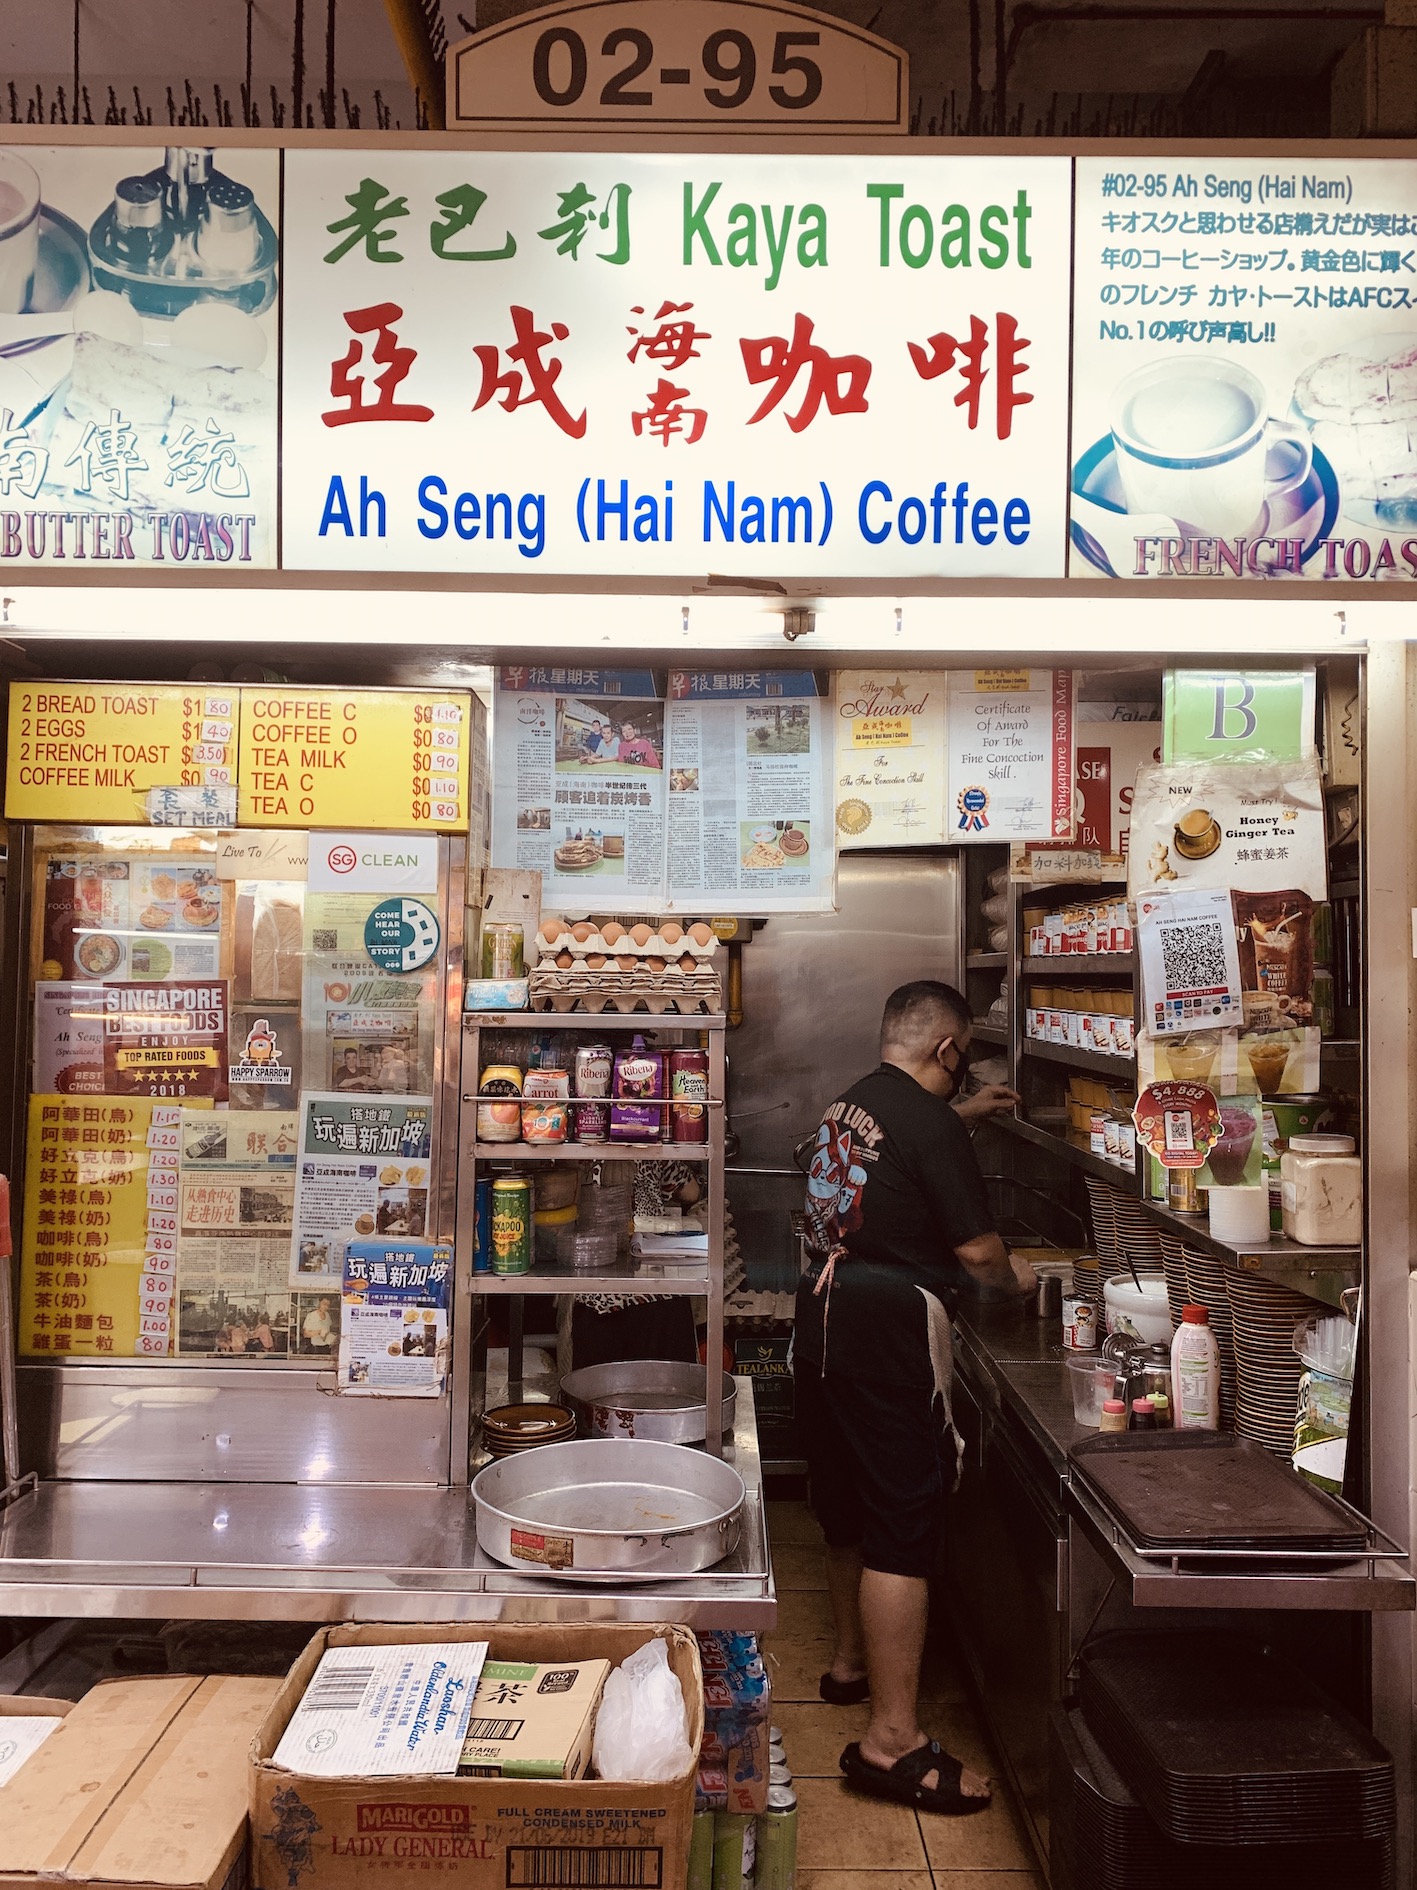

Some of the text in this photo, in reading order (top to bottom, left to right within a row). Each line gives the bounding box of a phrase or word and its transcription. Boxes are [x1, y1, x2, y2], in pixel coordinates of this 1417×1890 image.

[533, 27, 823, 109] 02-95
[1101, 173, 1353, 205] #02-95 Ah Seng (Hai Nam)
[683, 181, 1032, 291] Kaya Toast
[319, 475, 1031, 557] Ah Seng (Hai Nam) Coffee
[2, 510, 257, 562] BUTTER TOAST
[1134, 535, 1303, 578] FRENCH
[22, 694, 32, 713] 2
[37, 695, 96, 713] BREAD
[101, 696, 159, 715] TOAST
[253, 700, 357, 721] COFFEE C
[840, 693, 930, 719] Award
[975, 701, 1031, 717] Certificate
[1205, 676, 1258, 741] B
[21, 718, 31, 737] 2
[36, 719, 85, 738] EGGS
[977, 717, 1028, 734] Of Award
[1054, 709, 1068, 743] Food
[252, 724, 331, 744] COFFEE
[342, 727, 357, 745] O
[982, 733, 1023, 748] For The
[20, 743, 30, 761] 2
[35, 744, 106, 762] FRENCH
[112, 746, 170, 763] TOAST
[251, 748, 289, 767] TEA
[301, 750, 346, 768] MILK
[961, 752, 1044, 764] Fine Concoction
[20, 767, 89, 785] COFFEE
[95, 769, 135, 787] MILK
[251, 772, 289, 791] TEA
[300, 773, 314, 792] C
[1053, 746, 1070, 817] Singapore
[1168, 786, 1193, 795] NEW
[250, 796, 288, 815] TEA
[299, 798, 314, 816] O
[152, 811, 236, 826] SET MEAL
[1239, 816, 1279, 827] Honey
[1225, 827, 1295, 840] Ginger Tea
[221, 845, 262, 858] Live To
[332, 853, 419, 867] SG CLEAN
[106, 988, 223, 1012] SINGAPORE
[109, 1010, 219, 1033] BEST FOODS
[54, 1031, 102, 1044] Ah Seng
[141, 1036, 189, 1047] ENJOY
[124, 1050, 206, 1062] TOP RATED FOODS
[75, 1071, 102, 1080] BEST
[231, 1067, 290, 1077] HAPPY SPARROW
[580, 1068, 609, 1079] Ribena
[623, 1065, 653, 1076] Ribena
[150, 1084, 186, 1096] 2018
[523, 1083, 559, 1098] Carrot
[683, 1085, 705, 1094] Earth
[843, 1103, 885, 1149] LUCK
[151, 1133, 177, 1145] 1.20
[312, 1116, 426, 1154] 玩遍新加坡
[152, 1154, 177, 1166] 1.20
[150, 1173, 176, 1186] 1.30
[150, 1194, 174, 1206] 1.10
[151, 1217, 176, 1230] 1.20
[154, 1238, 173, 1249] 80
[149, 1257, 169, 1271] 90
[348, 1257, 449, 1288] 玩遍新加坡
[146, 1280, 167, 1292] 80
[144, 1300, 166, 1312] 90
[142, 1319, 167, 1332] 1.00
[142, 1339, 163, 1351] 80
[482, 1683, 528, 1704] 茶
[433, 1677, 464, 1736] Laoshan
[406, 1719, 429, 1751] Water
[361, 1807, 464, 1829] MARIGOLD
[497, 1808, 667, 1818] FULL CREAM SWEETENED
[522, 1818, 641, 1829] CONDENSED MILK
[331, 1835, 492, 1860] LADY GENERAL
